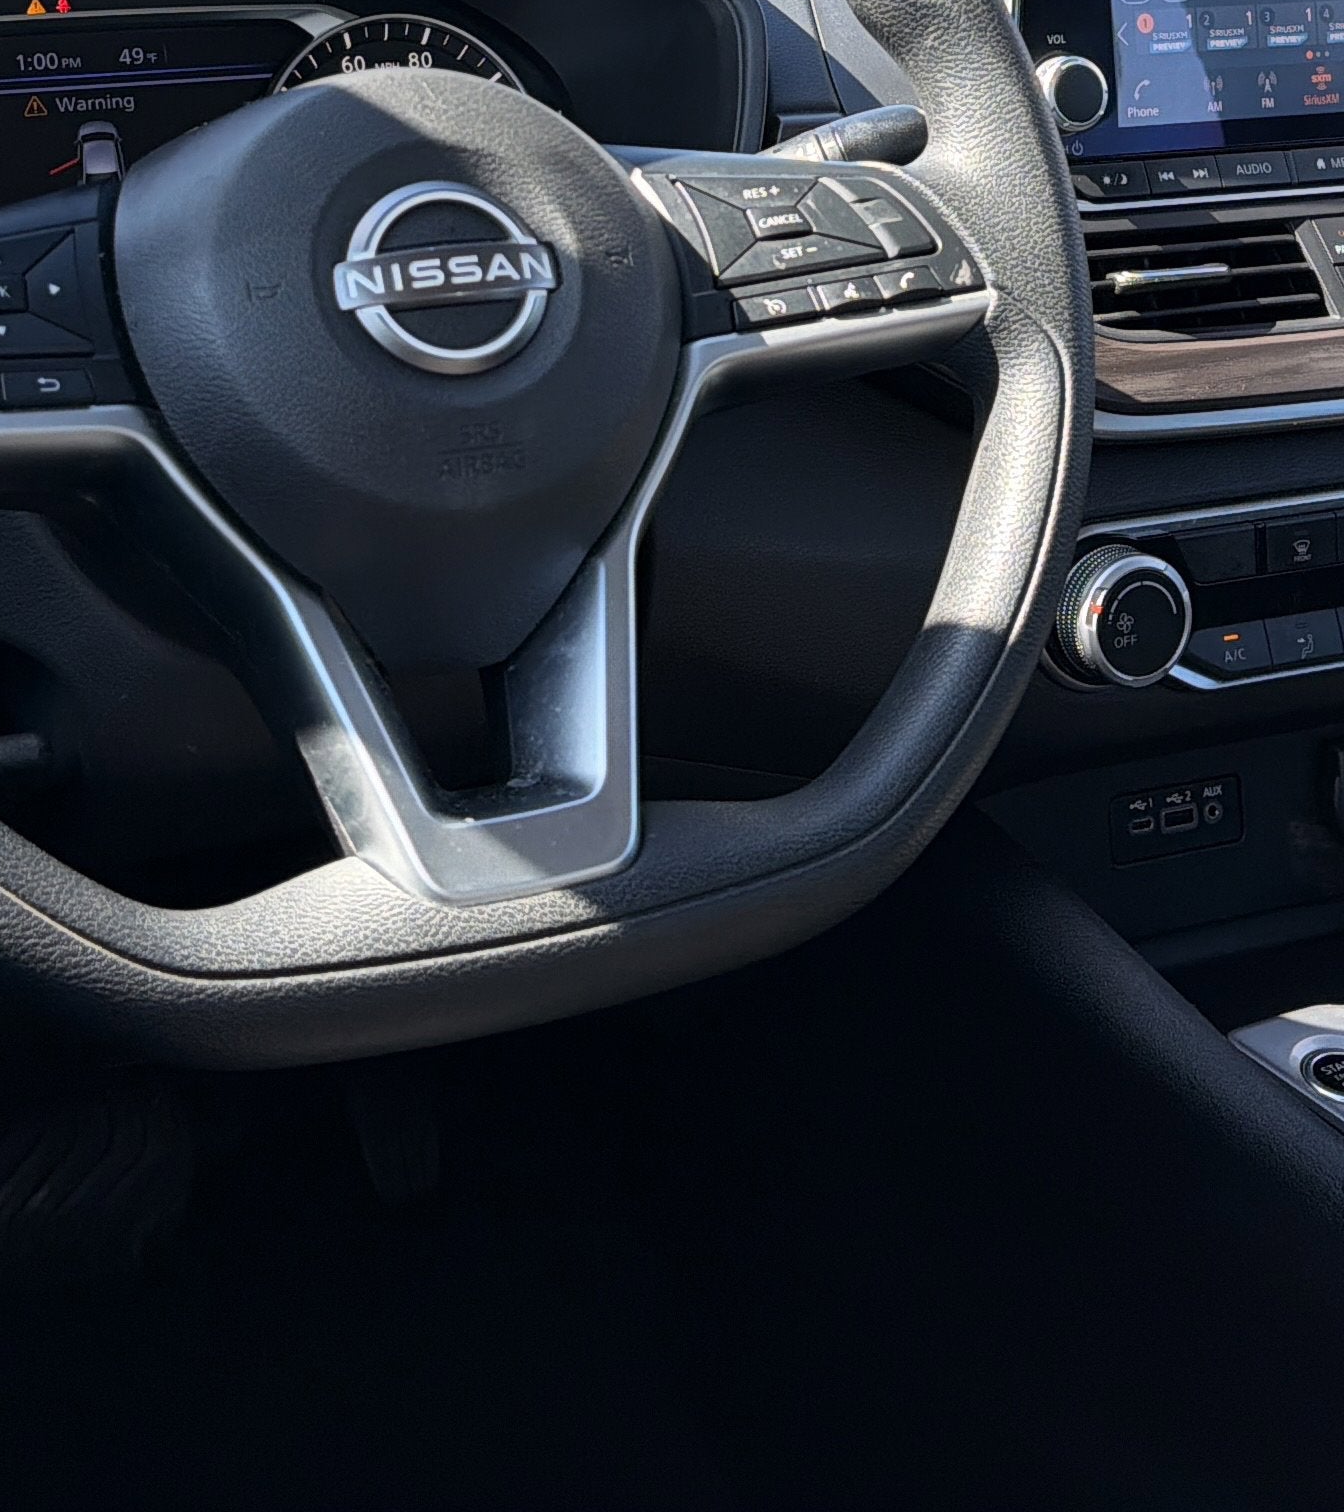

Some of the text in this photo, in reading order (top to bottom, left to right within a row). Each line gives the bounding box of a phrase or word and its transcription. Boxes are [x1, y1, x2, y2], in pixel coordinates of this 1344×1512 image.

[1047, 35, 1066, 45] VOL
[16, 52, 82, 71] 1:00 PM
[341, 55, 366, 74] 60
[408, 51, 433, 68] 80
[55, 93, 135, 113] Warning
[1207, 101, 1223, 112] AM
[1261, 98, 1274, 109] FM
[1303, 93, 1340, 106] SiriusXM
[1127, 106, 1159, 118] Phone
[1236, 161, 1272, 176] AUDIO
[742, 186, 768, 199] RES
[758, 213, 803, 229] CANCEL
[781, 245, 803, 259] SET
[344, 252, 553, 299] NISSAN
[1113, 634, 1138, 649] OFF
[1224, 648, 1247, 663] A/C
[1202, 784, 1223, 798] AUX
